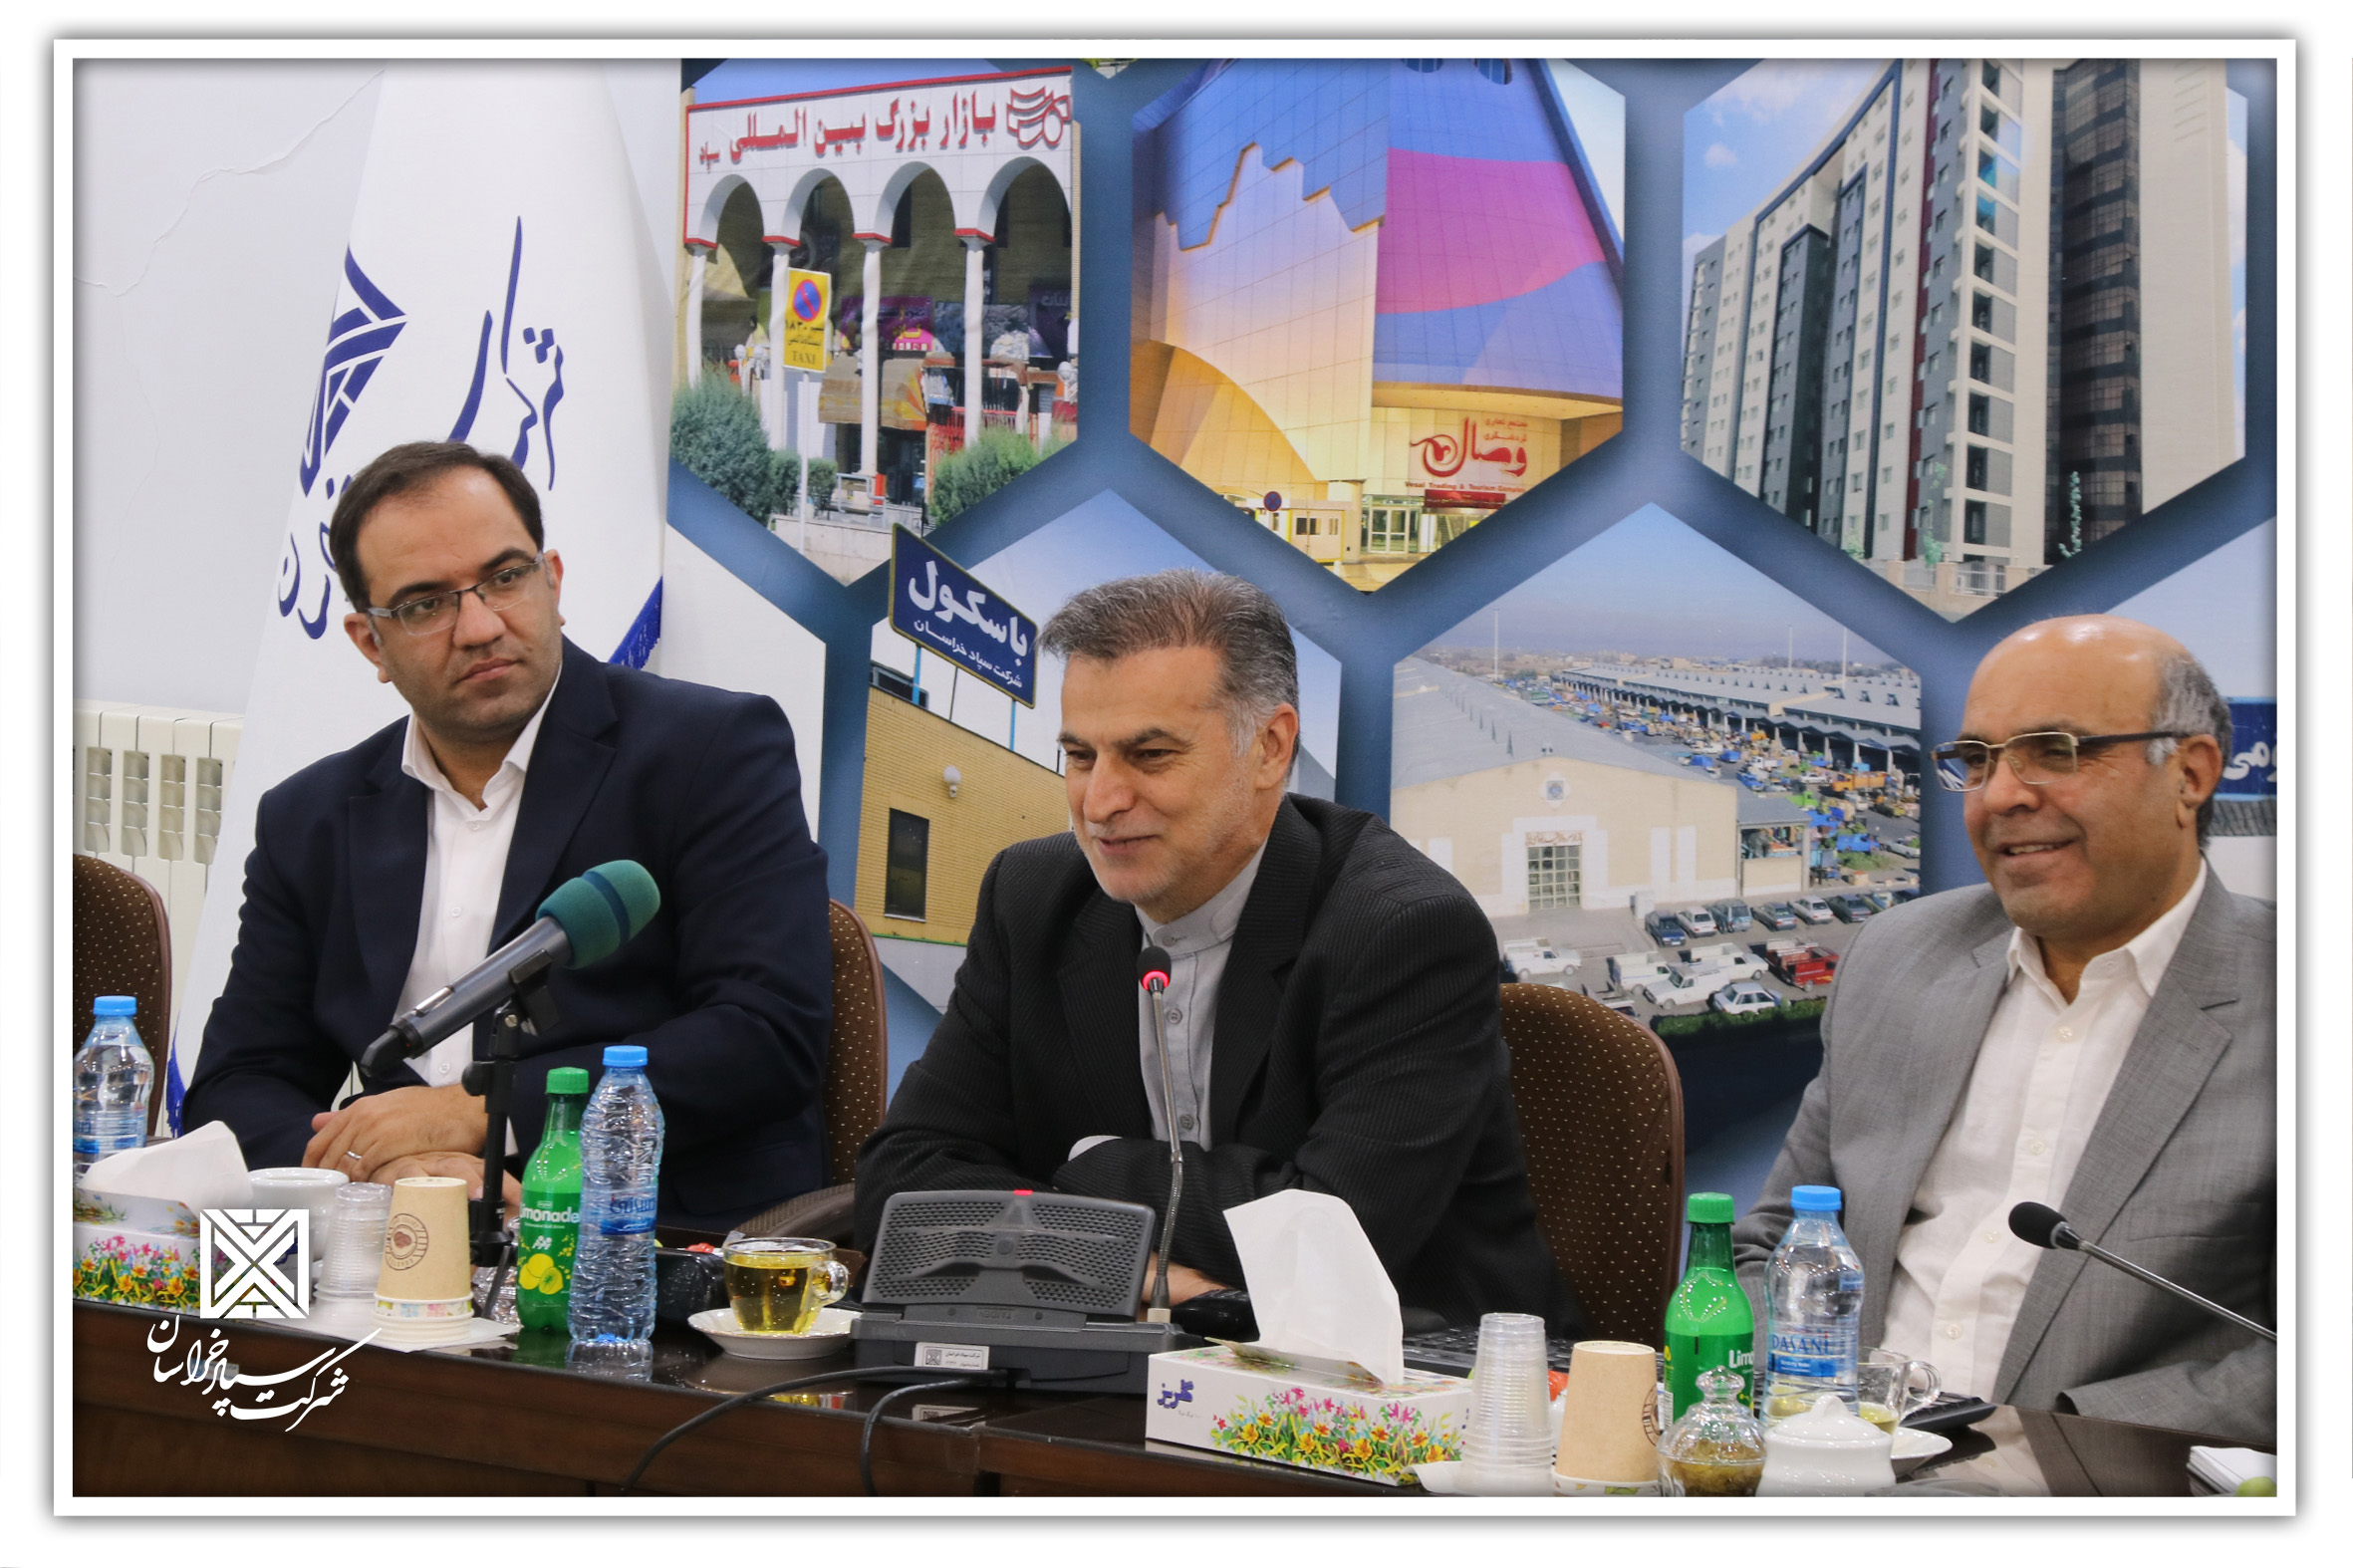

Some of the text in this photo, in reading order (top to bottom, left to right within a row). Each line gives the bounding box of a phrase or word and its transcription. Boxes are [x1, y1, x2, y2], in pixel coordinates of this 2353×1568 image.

[729, 107, 807, 161] المللی
[814, 112, 866, 156] بین
[876, 97, 930, 149] بزرگ
[939, 90, 996, 147] بازار
[1410, 416, 1527, 478] وصال
[909, 560, 1027, 666] باسکول
[914, 620, 1022, 687] شرکت سپاد خراسان
[520, 1203, 580, 1223] imonade
[1771, 1331, 1830, 1355] DASANI
